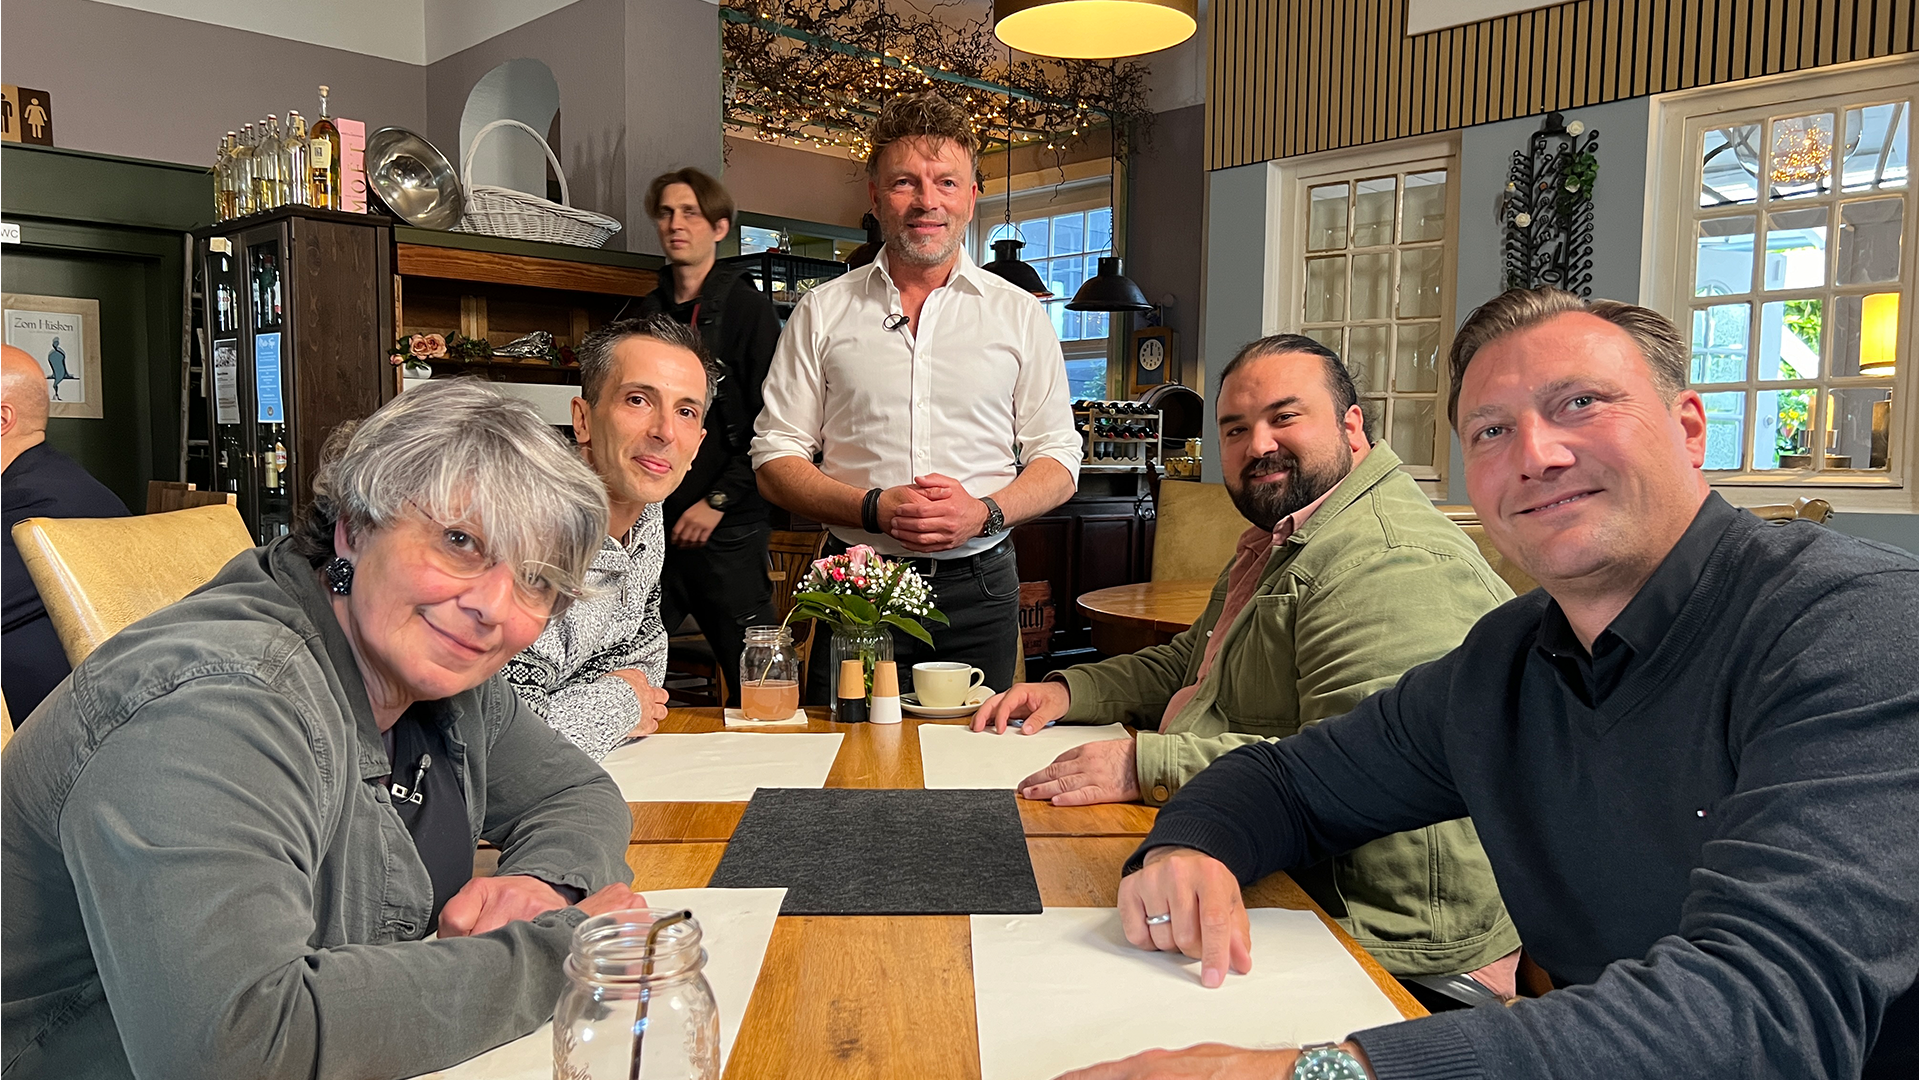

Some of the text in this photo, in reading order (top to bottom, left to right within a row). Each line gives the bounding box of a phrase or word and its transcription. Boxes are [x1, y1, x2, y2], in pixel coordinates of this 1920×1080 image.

[1, 228, 19, 239] WC
[14, 317, 74, 331] Zom Hüsken
